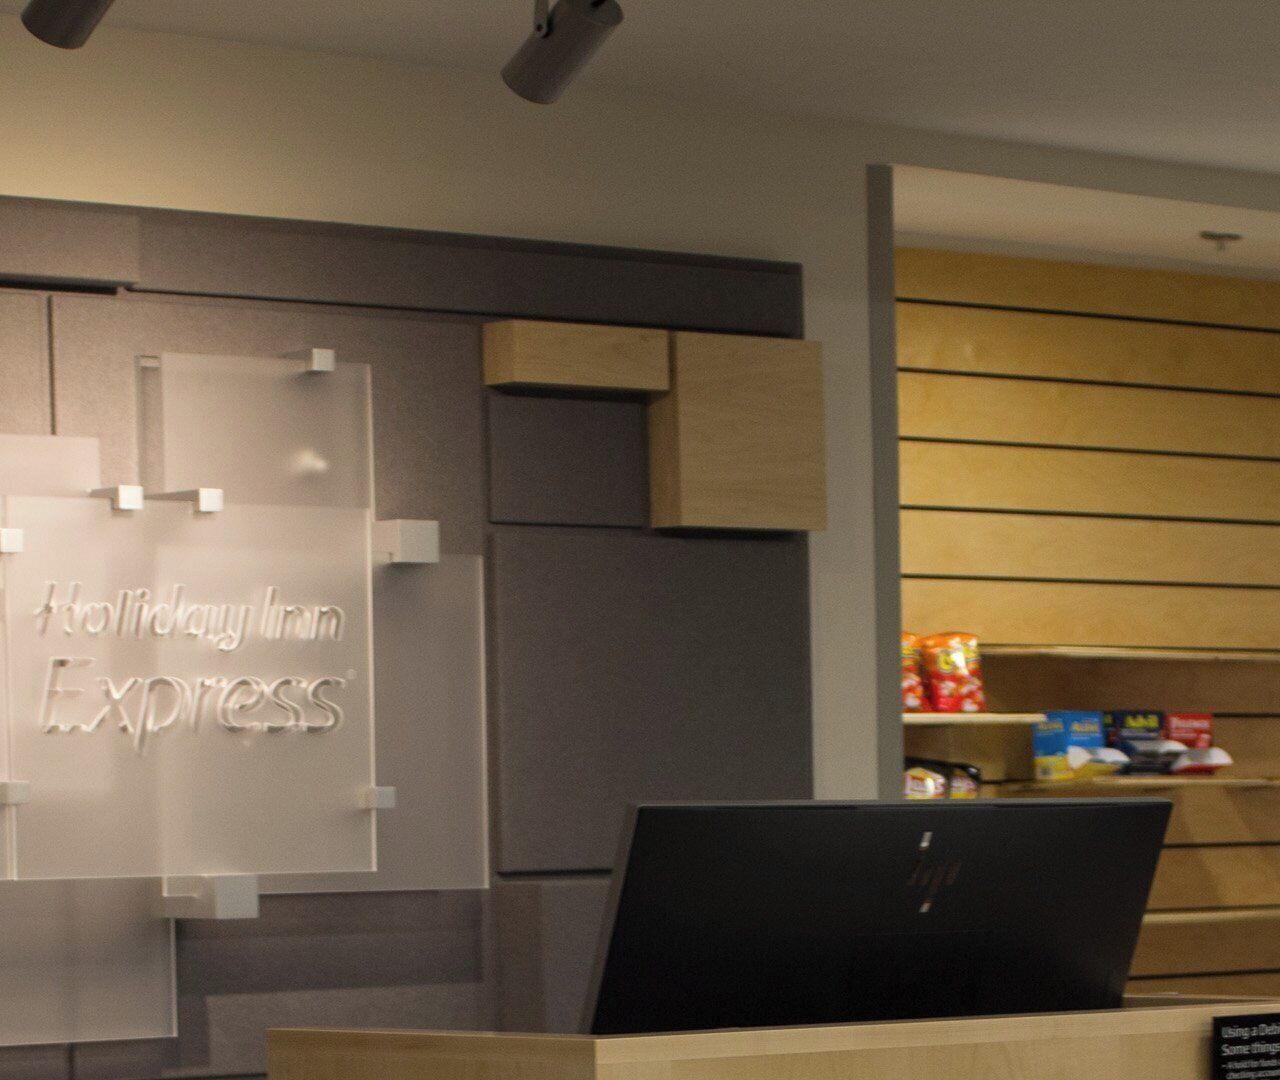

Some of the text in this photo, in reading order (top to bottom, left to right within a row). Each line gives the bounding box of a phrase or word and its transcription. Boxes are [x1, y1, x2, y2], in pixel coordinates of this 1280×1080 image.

[34, 580, 346, 651] Holiday Inn
[38, 656, 346, 752] Express
[1221, 1025, 1250, 1039] Using
[1221, 1043, 1250, 1056] Some
